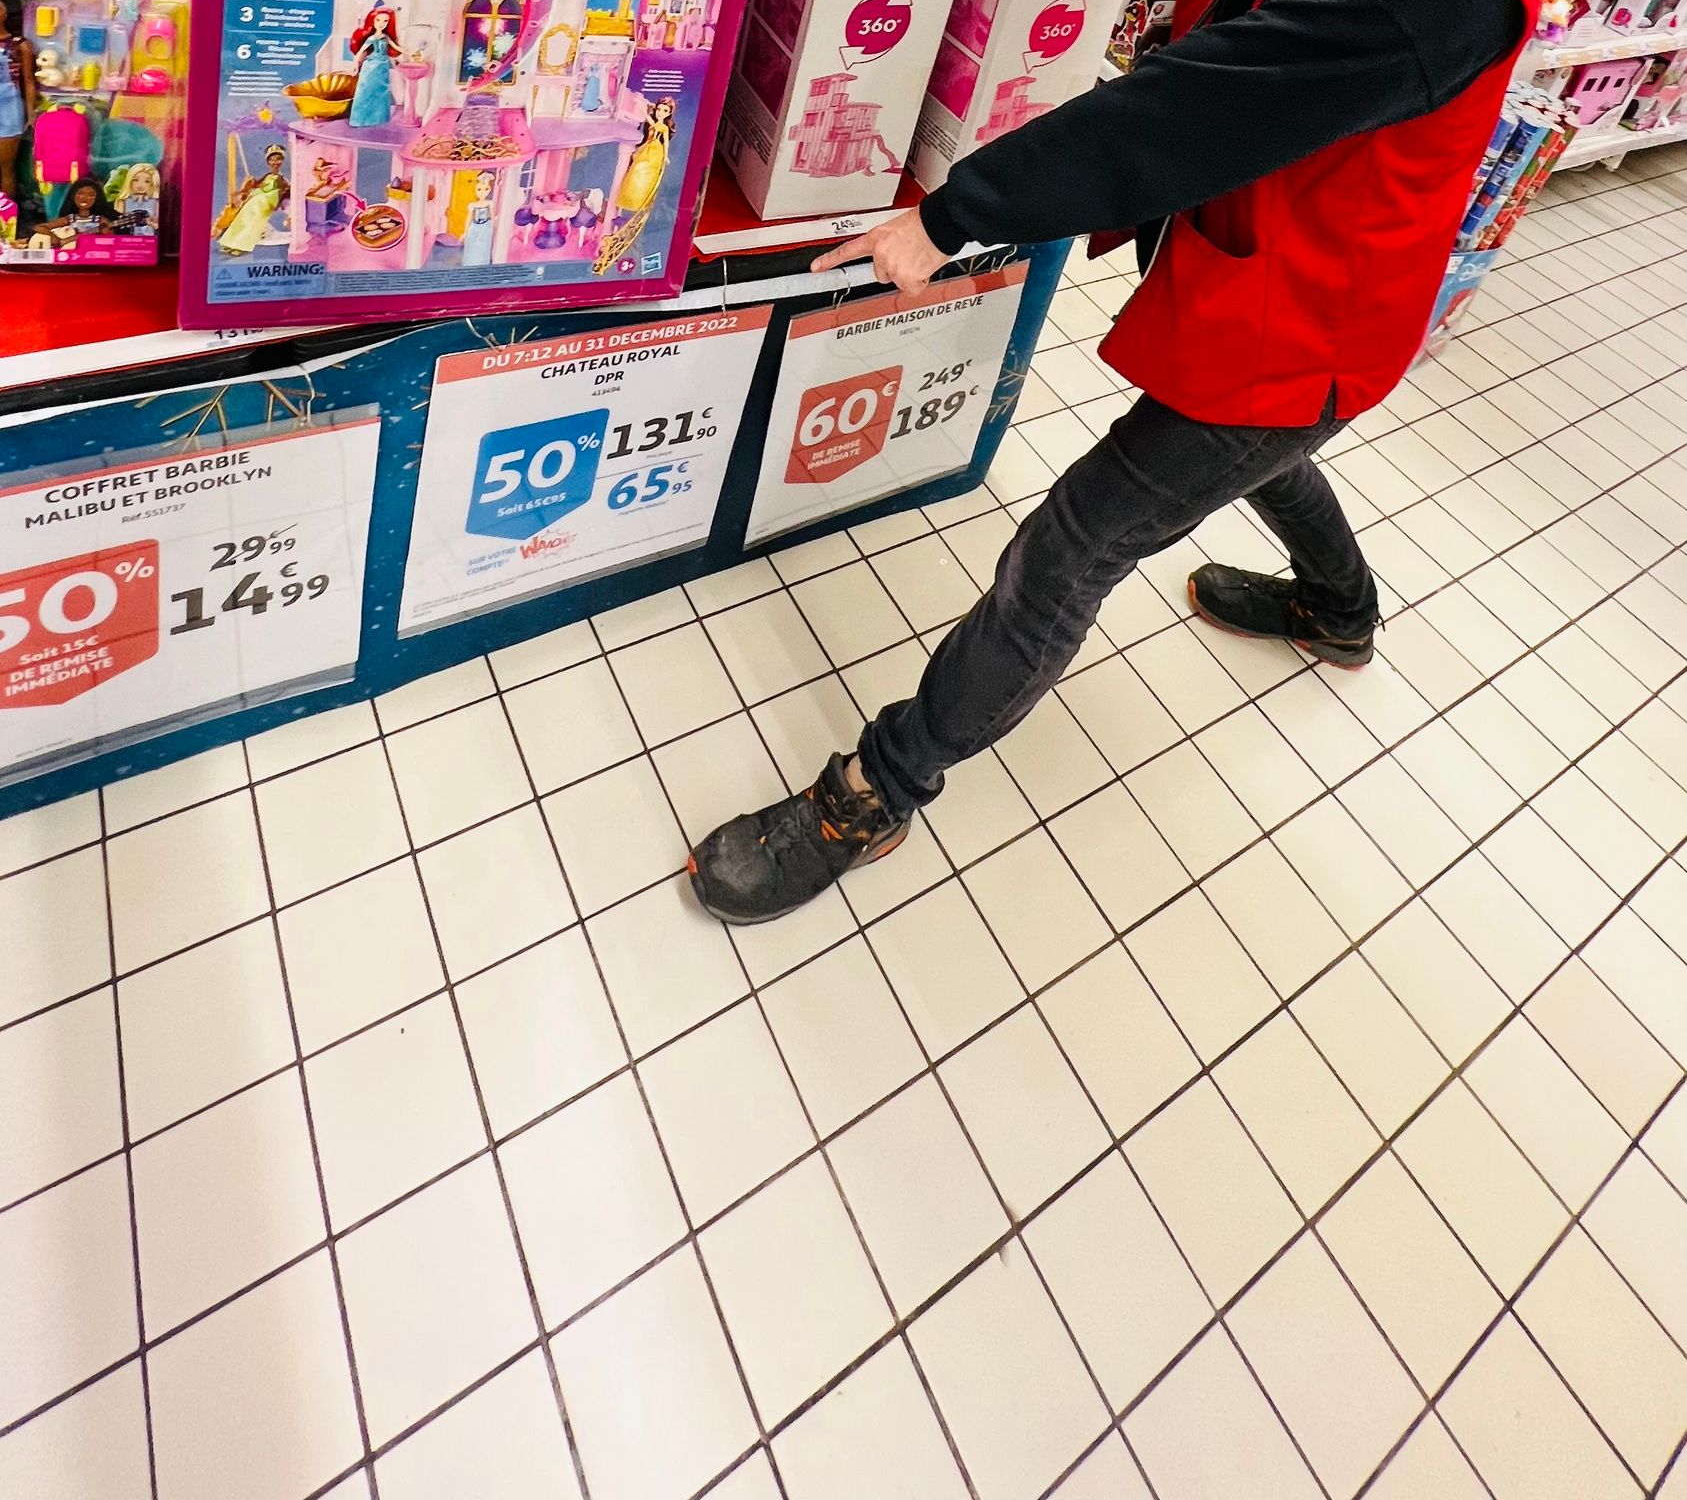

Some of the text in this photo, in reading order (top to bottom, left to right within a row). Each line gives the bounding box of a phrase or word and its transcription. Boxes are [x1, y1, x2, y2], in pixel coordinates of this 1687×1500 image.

[240, 6, 254, 22] 3
[237, 44, 251, 59] 6
[247, 263, 324, 278] WARNING:
[836, 318, 882, 340] BARBIE
[884, 307, 935, 328] MAISON
[936, 300, 952, 316] DE
[953, 295, 984, 312] REVE
[482, 352, 511, 370] DU
[554, 341, 582, 358] AU
[586, 337, 605, 351] 31
[608, 324, 695, 347] DECEMBRE
[697, 316, 739, 334] 2022
[541, 344, 681, 380] CHATEAU ROYAL
[594, 371, 625, 386] DPR
[45, 451, 251, 504] COFFRET BARBIE
[24, 466, 272, 529] MALIBU ET BROOKLYN
[497, 503, 524, 517] Soit
[10, 646, 109, 684] DE REMISE
[20, 635, 100, 665] Soit 15€
[4, 656, 114, 697] IMMÉDIATE
